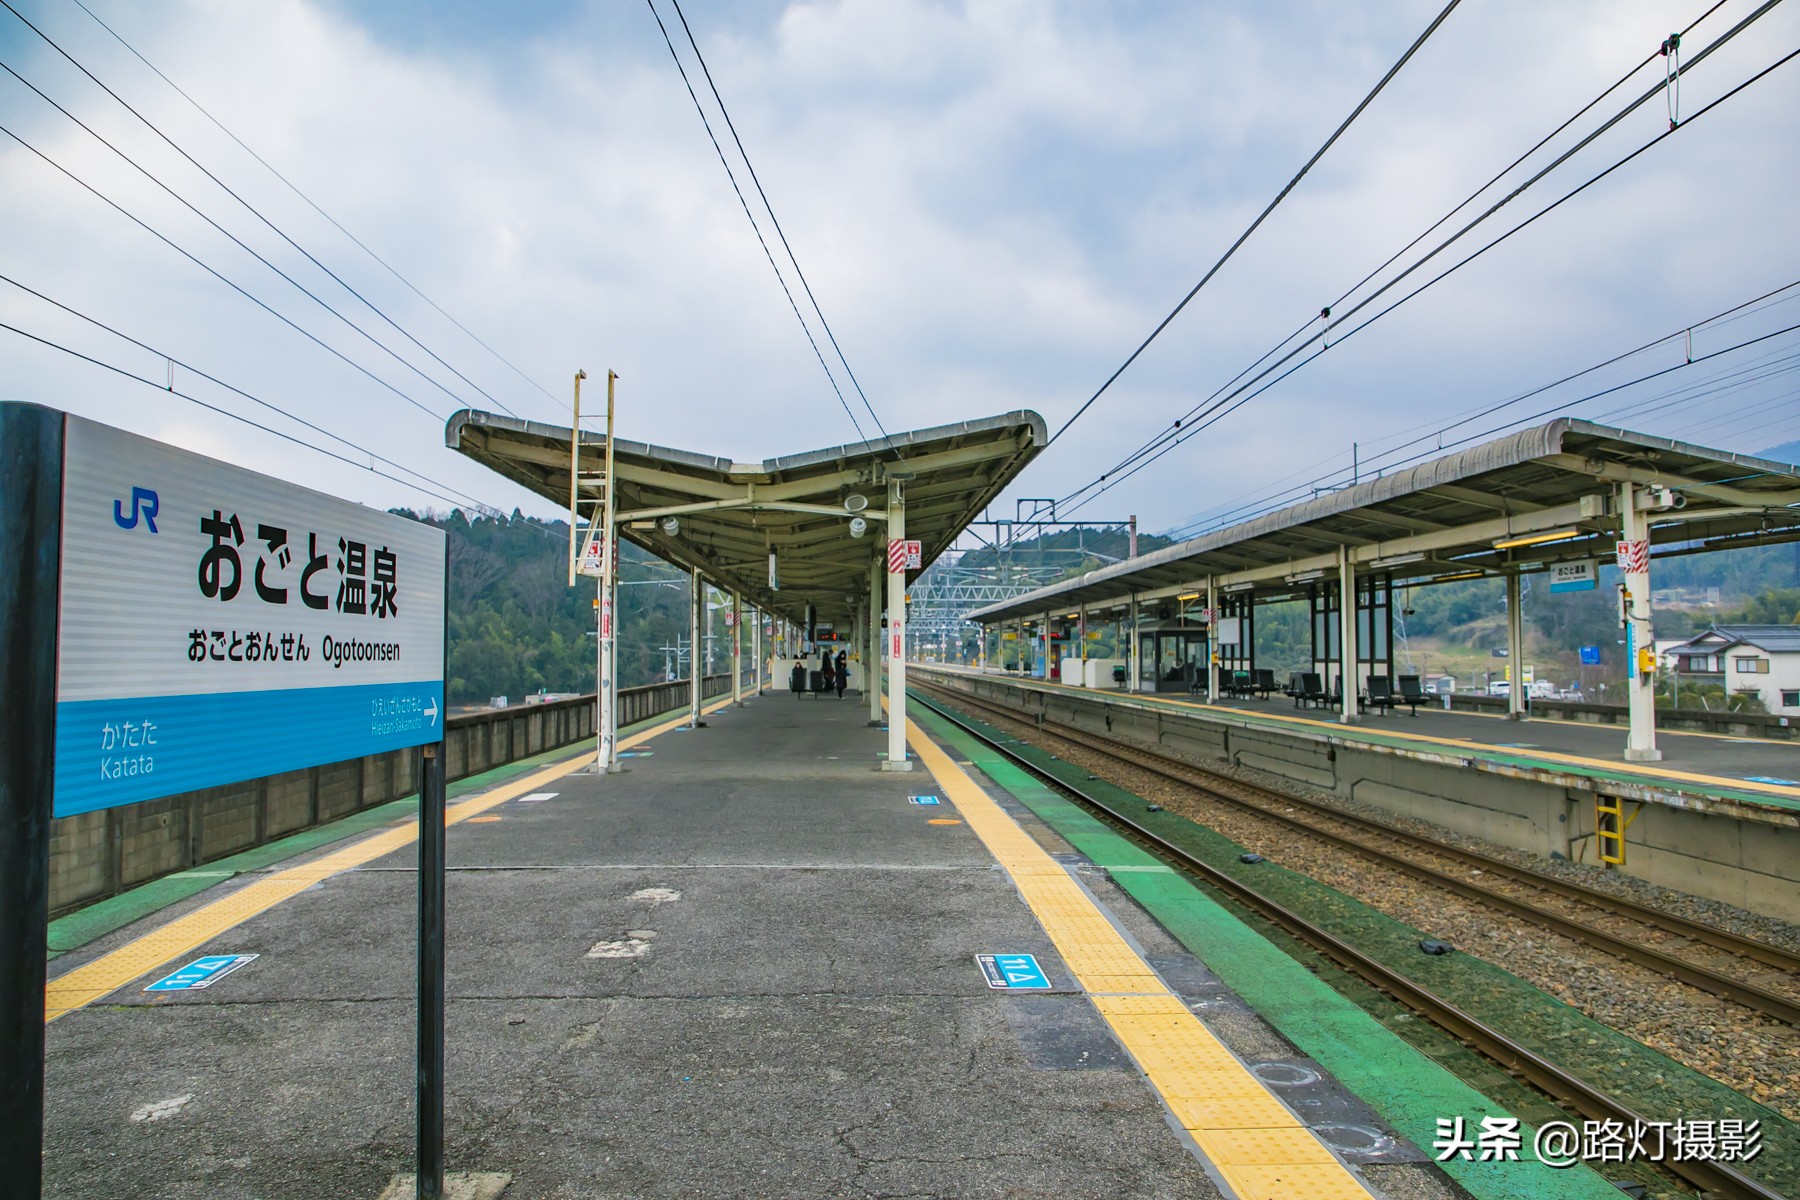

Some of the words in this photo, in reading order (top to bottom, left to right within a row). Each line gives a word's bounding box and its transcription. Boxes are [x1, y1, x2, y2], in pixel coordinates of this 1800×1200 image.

[114, 486, 159, 534] JR
[198, 509, 398, 619] おごと温泉
[188, 629, 310, 662] おごとおんせん
[322, 634, 400, 668] Ogotoonsen
[101, 719, 157, 750] かたた
[101, 754, 153, 781] Katata
